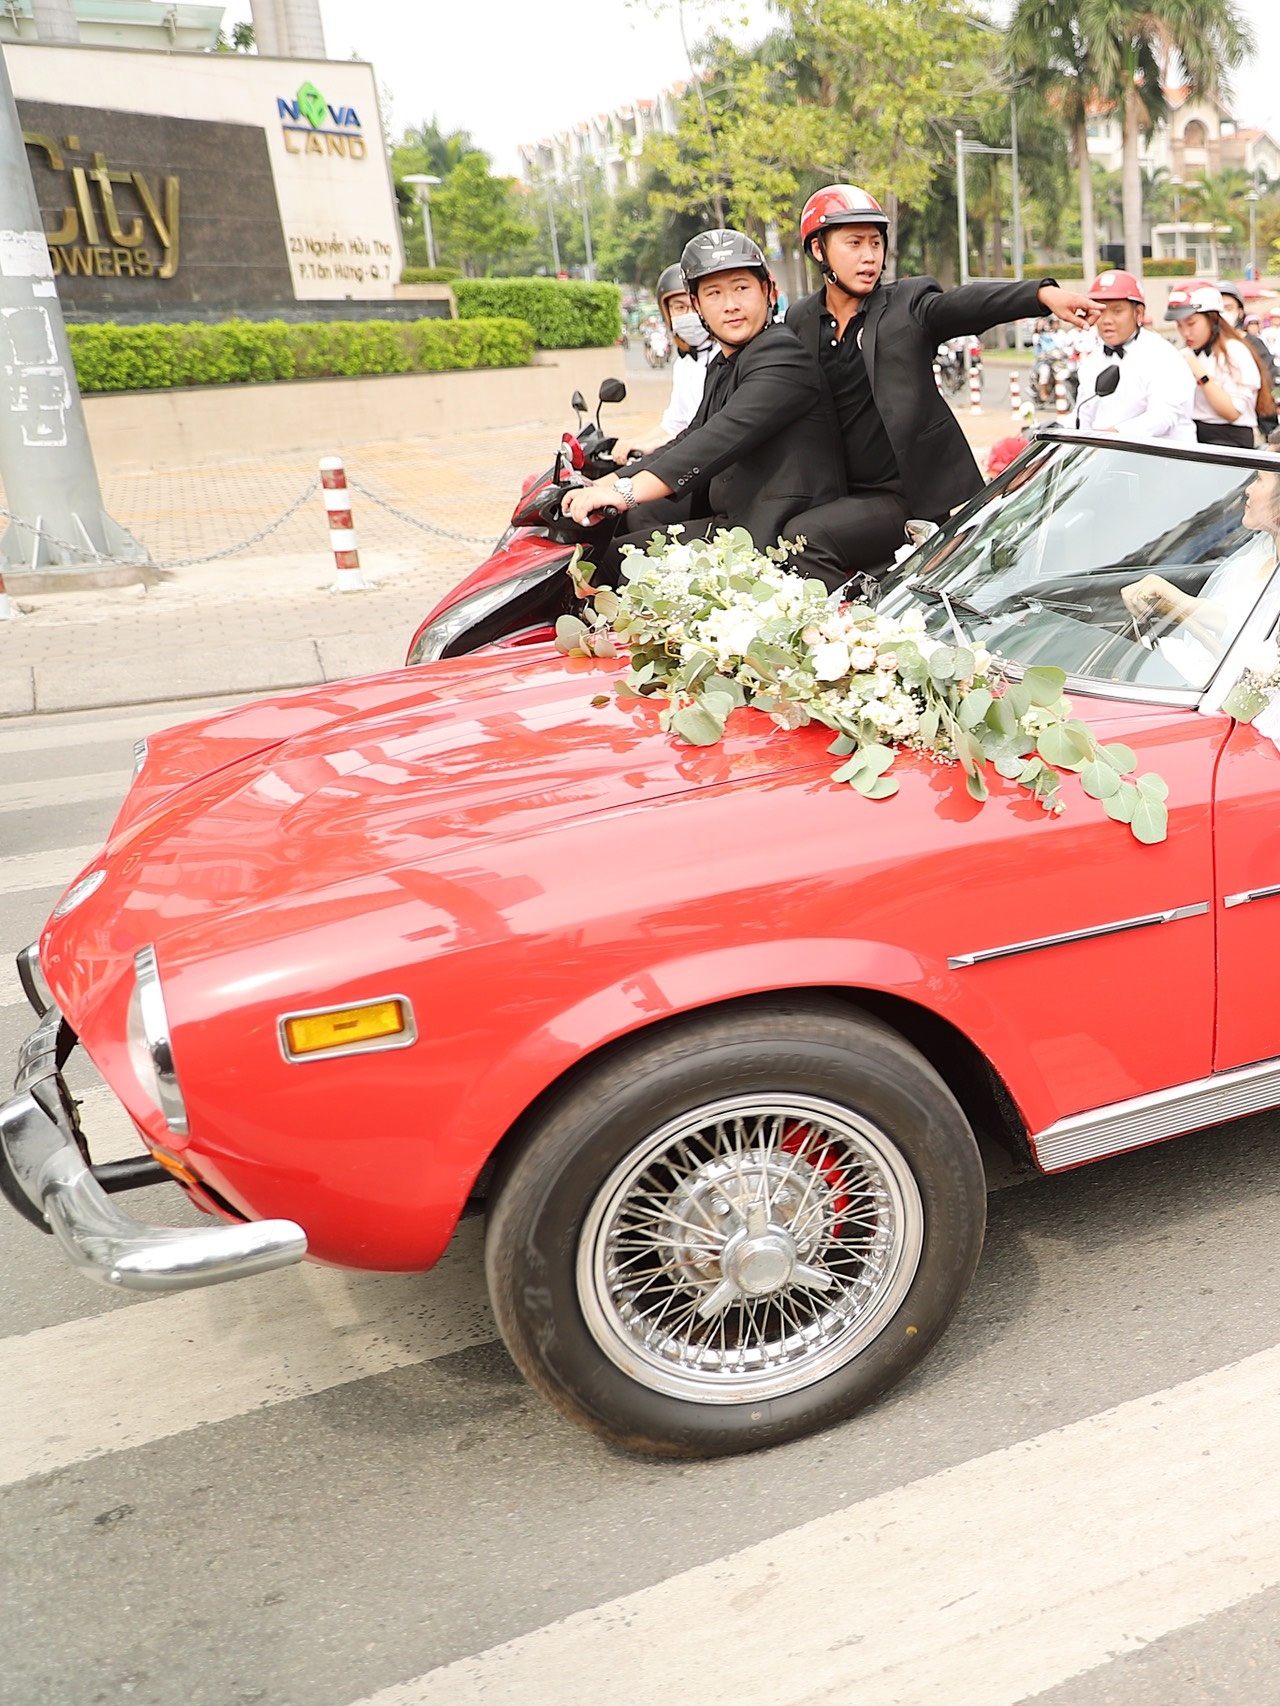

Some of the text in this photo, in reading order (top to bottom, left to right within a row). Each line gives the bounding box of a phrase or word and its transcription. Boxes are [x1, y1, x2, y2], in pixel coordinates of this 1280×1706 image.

[277, 81, 362, 128] NOVA
[283, 127, 368, 160] LAND
[48, 245, 154, 278] OWERS
[289, 237, 303, 253] 23
[947, 1155, 971, 1271] TURANZA
